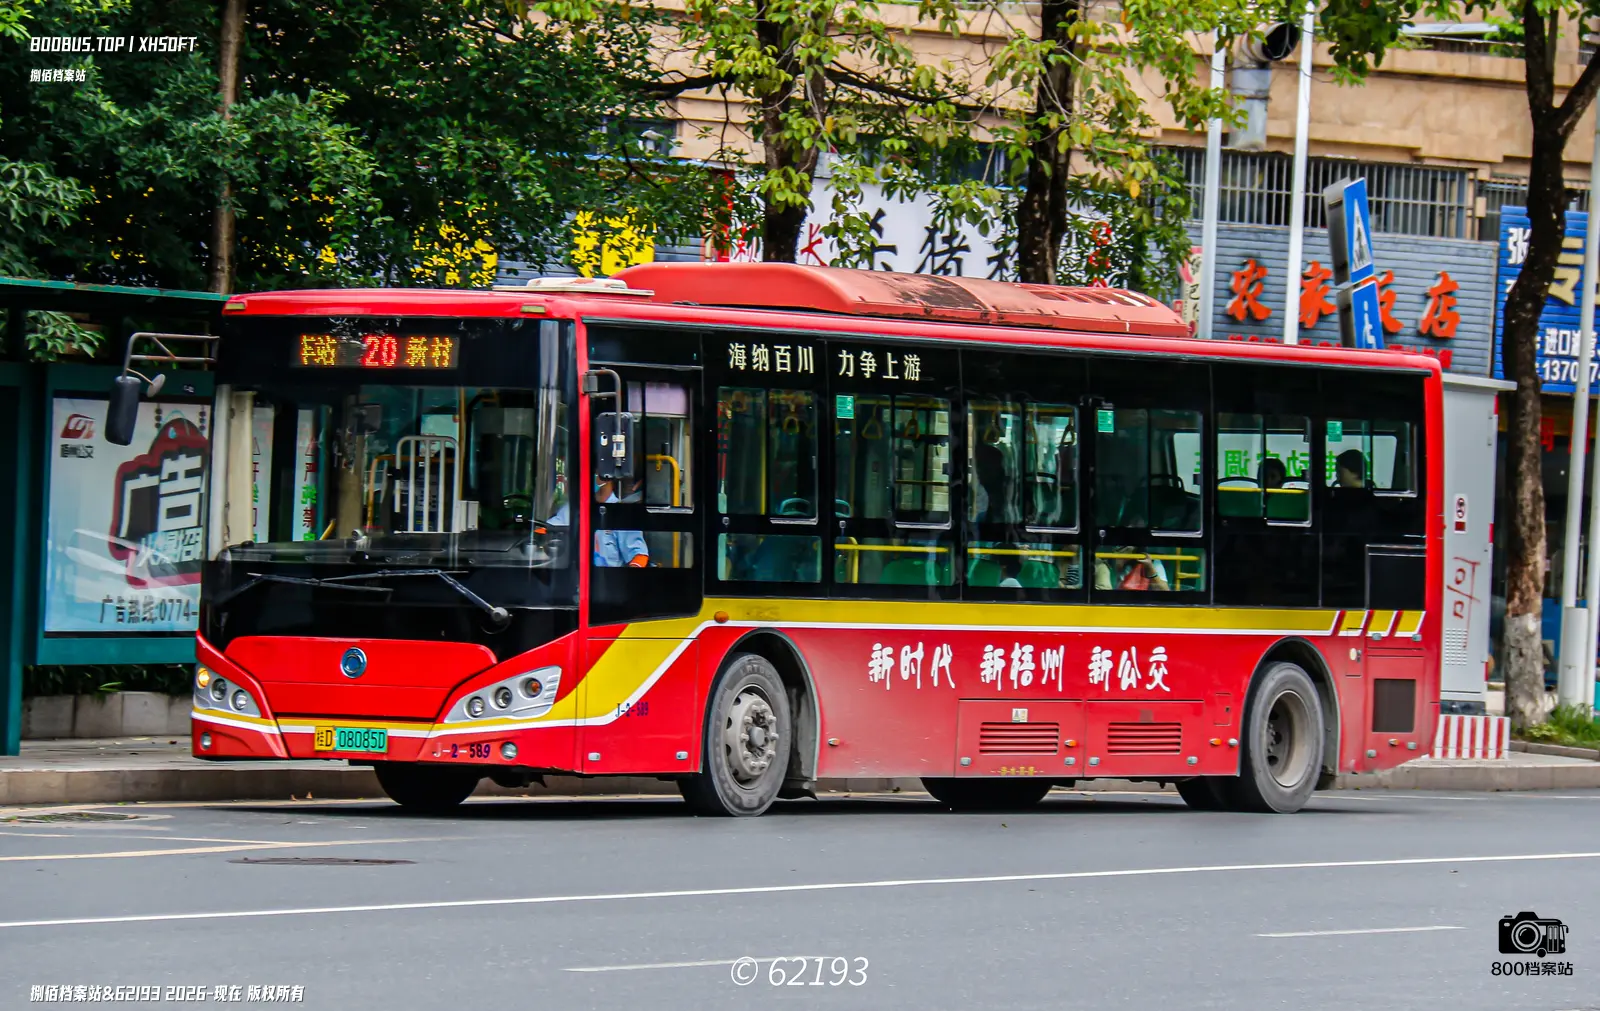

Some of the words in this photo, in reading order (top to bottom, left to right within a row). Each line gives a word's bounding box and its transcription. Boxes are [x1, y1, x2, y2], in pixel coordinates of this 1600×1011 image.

[364, 336, 398, 367] 20
[728, 342, 815, 374] 海纳百川
[838, 349, 921, 382] 力争上游
[1542, 359, 1600, 384] 13707
[868, 642, 956, 690] 新时代
[980, 642, 1065, 692] 新梧州
[1088, 646, 1171, 692] 新公交
